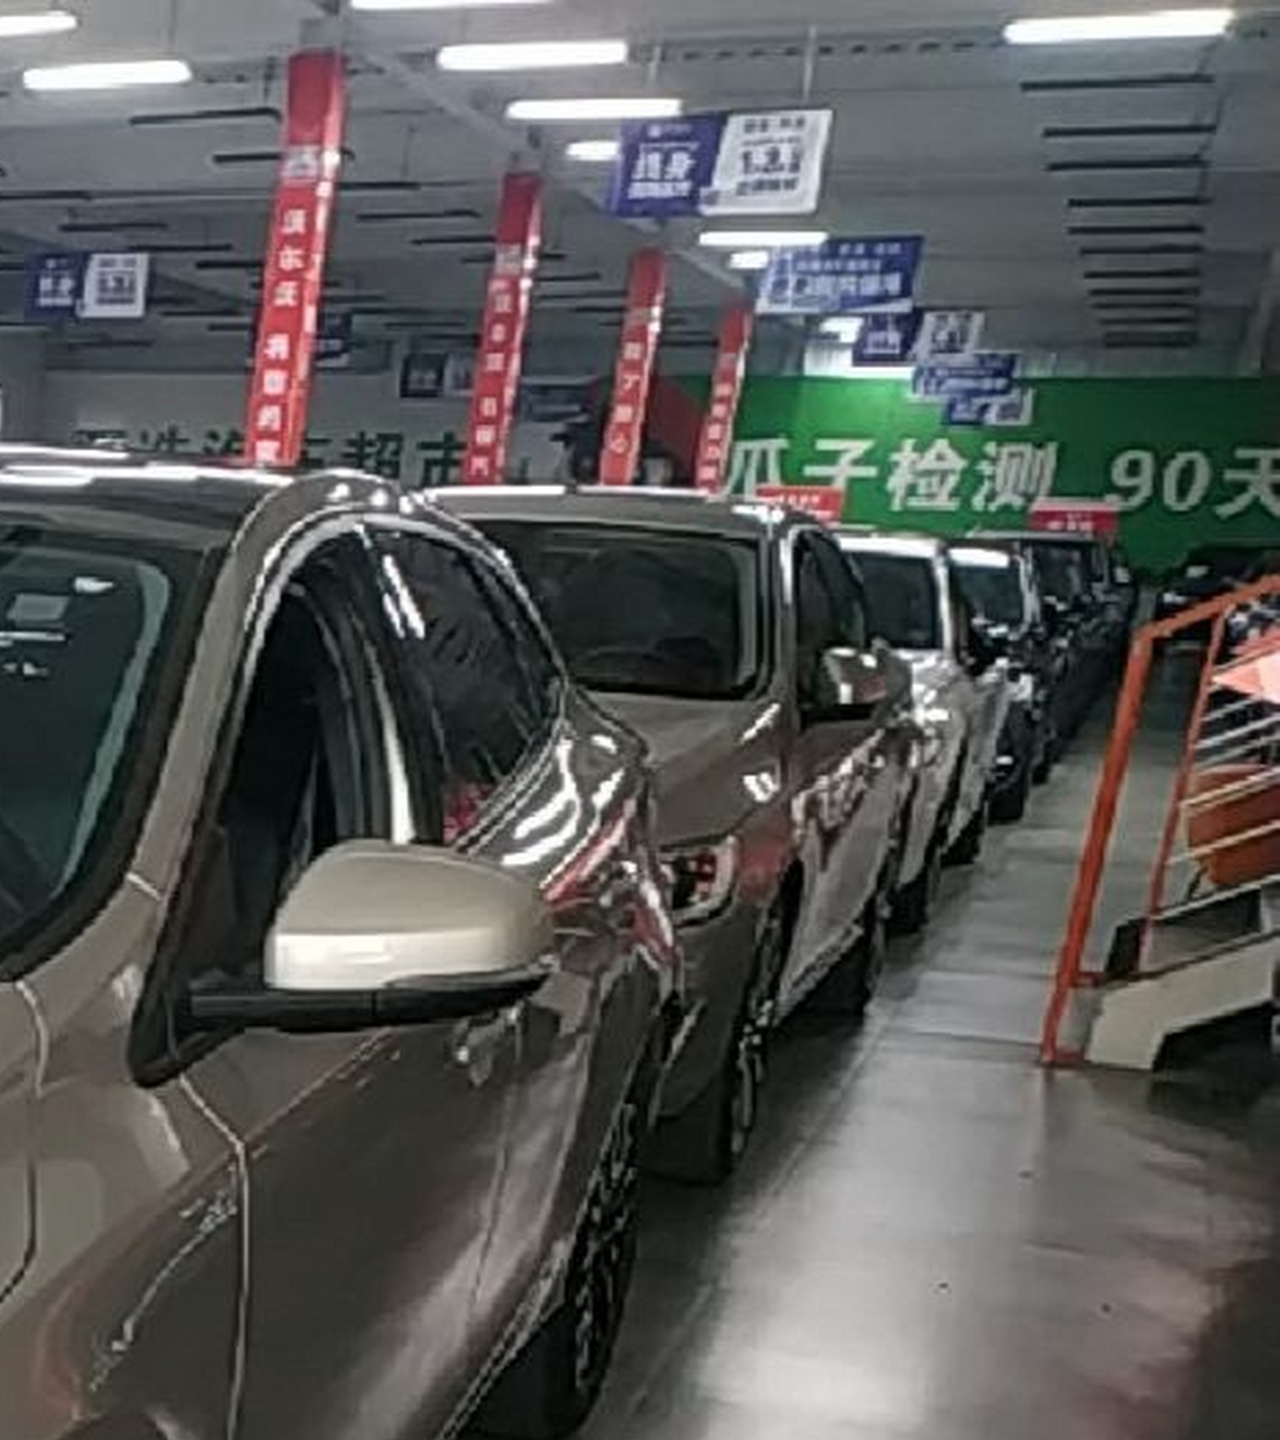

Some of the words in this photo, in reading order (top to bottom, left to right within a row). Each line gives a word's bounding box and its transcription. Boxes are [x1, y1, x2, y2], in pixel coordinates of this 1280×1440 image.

[723, 436, 1059, 513] 瓜子检测
[1103, 447, 1280, 520] 90天
